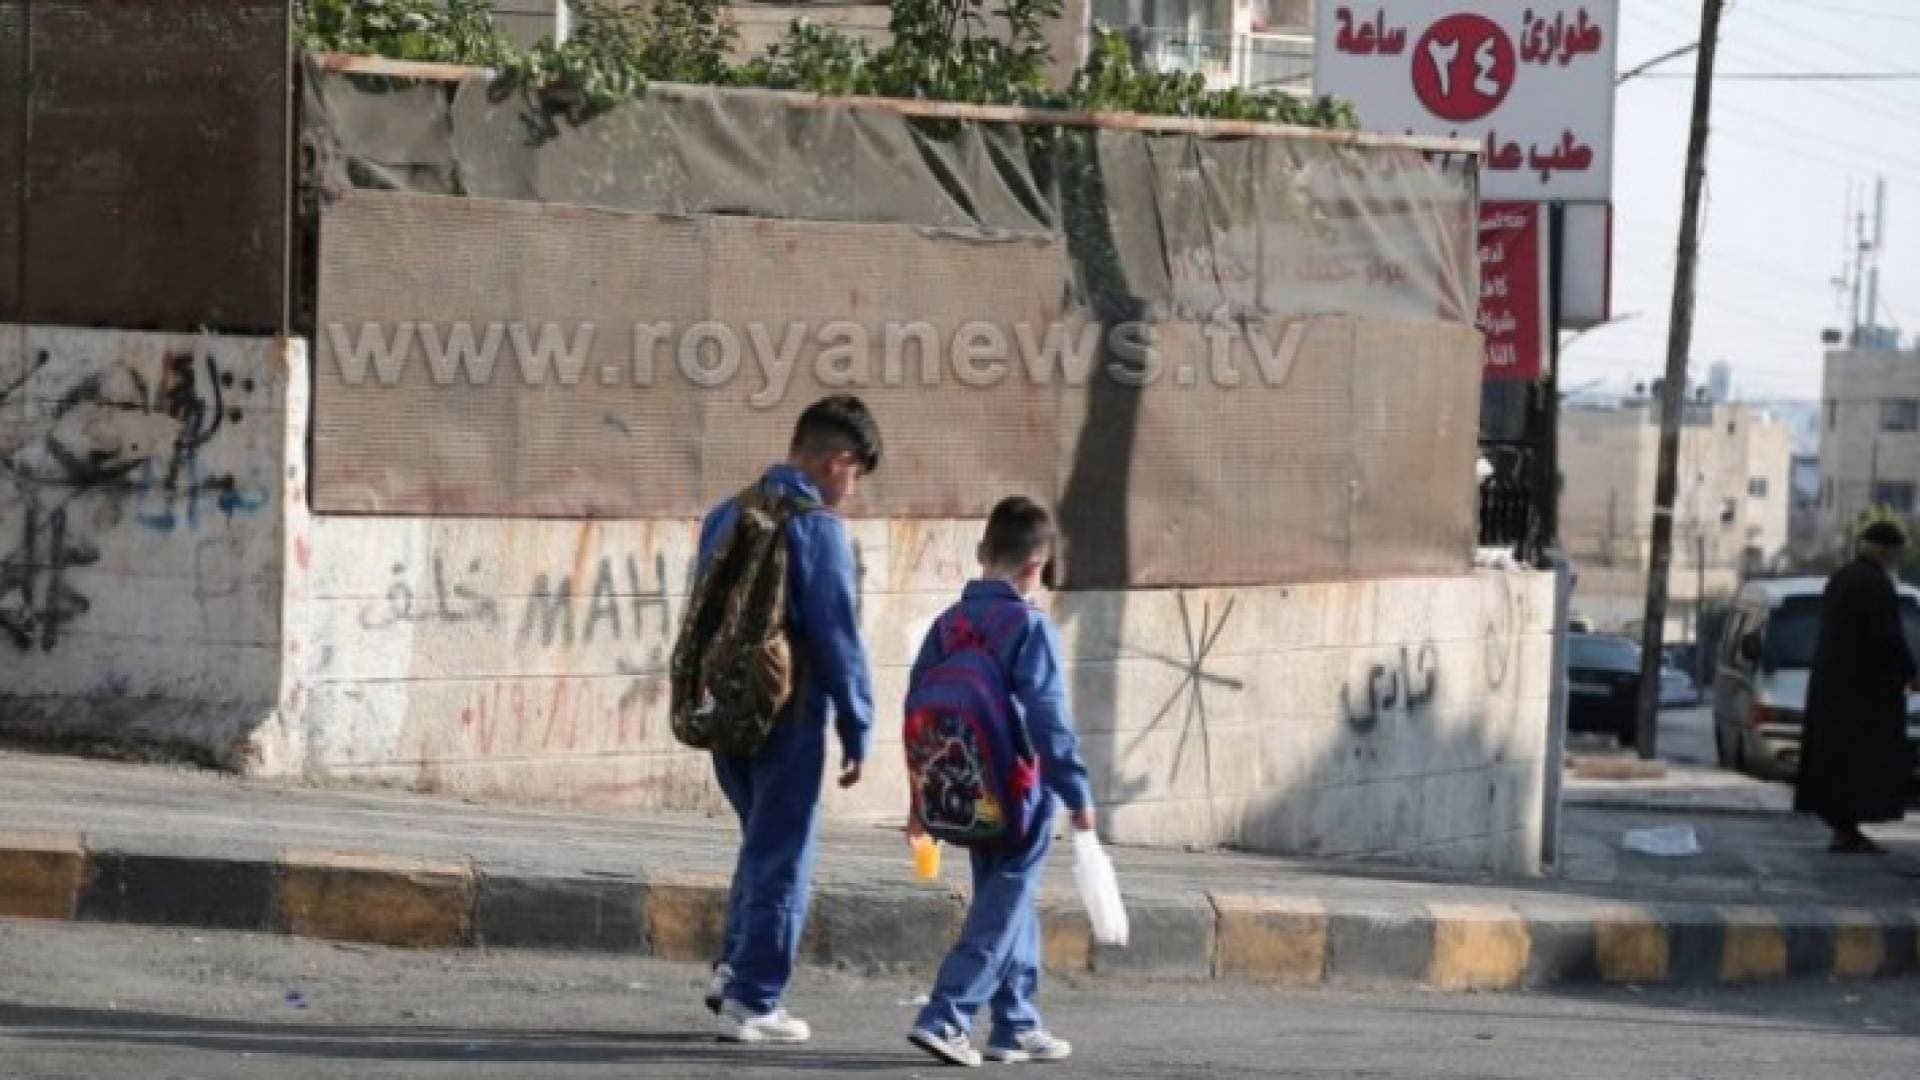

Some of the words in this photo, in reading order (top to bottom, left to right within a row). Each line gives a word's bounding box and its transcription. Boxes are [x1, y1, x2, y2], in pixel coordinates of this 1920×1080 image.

[1334, 6, 1407, 54] ساعة
[1519, 8, 1601, 66] طوارئ
[1428, 37, 1501, 97] ٢٤
[1481, 128, 1523, 170] عا
[1529, 128, 1594, 184] طب
[513, 550, 698, 652] MAH
